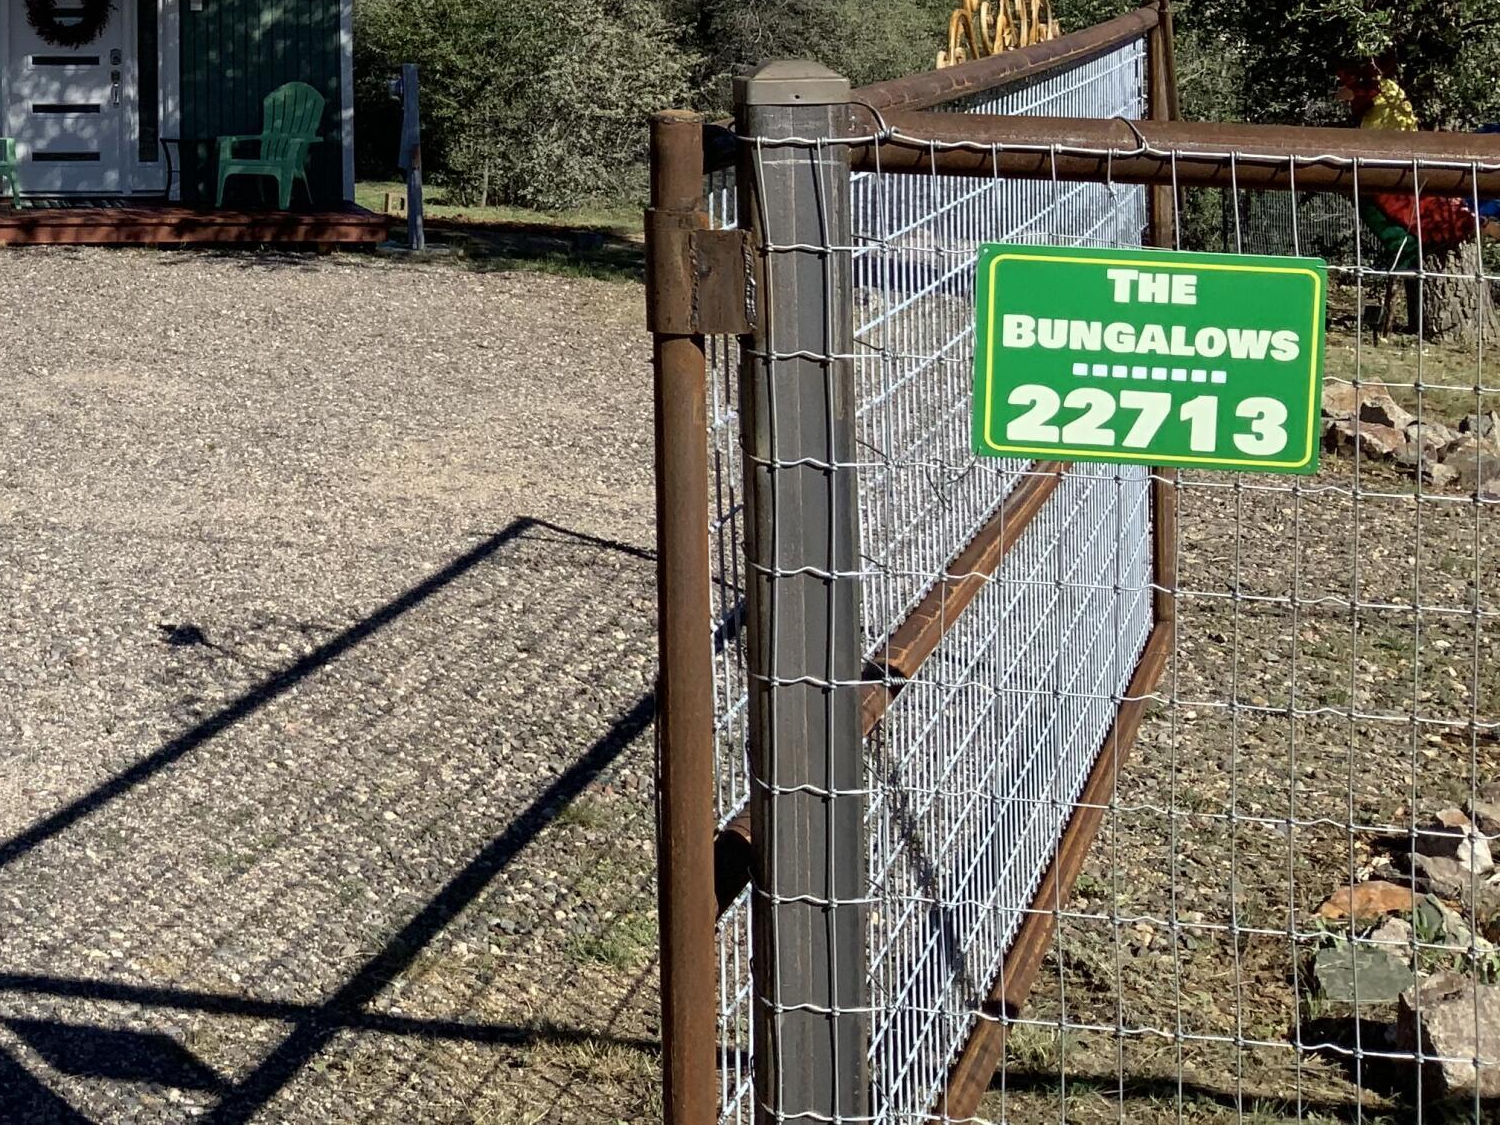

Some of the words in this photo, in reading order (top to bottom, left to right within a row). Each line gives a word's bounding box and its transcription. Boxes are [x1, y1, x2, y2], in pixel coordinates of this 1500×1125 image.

[1106, 268, 1198, 305] THE
[1002, 314, 1300, 361] BUNGALOWS
[1006, 384, 1288, 456] 22713
